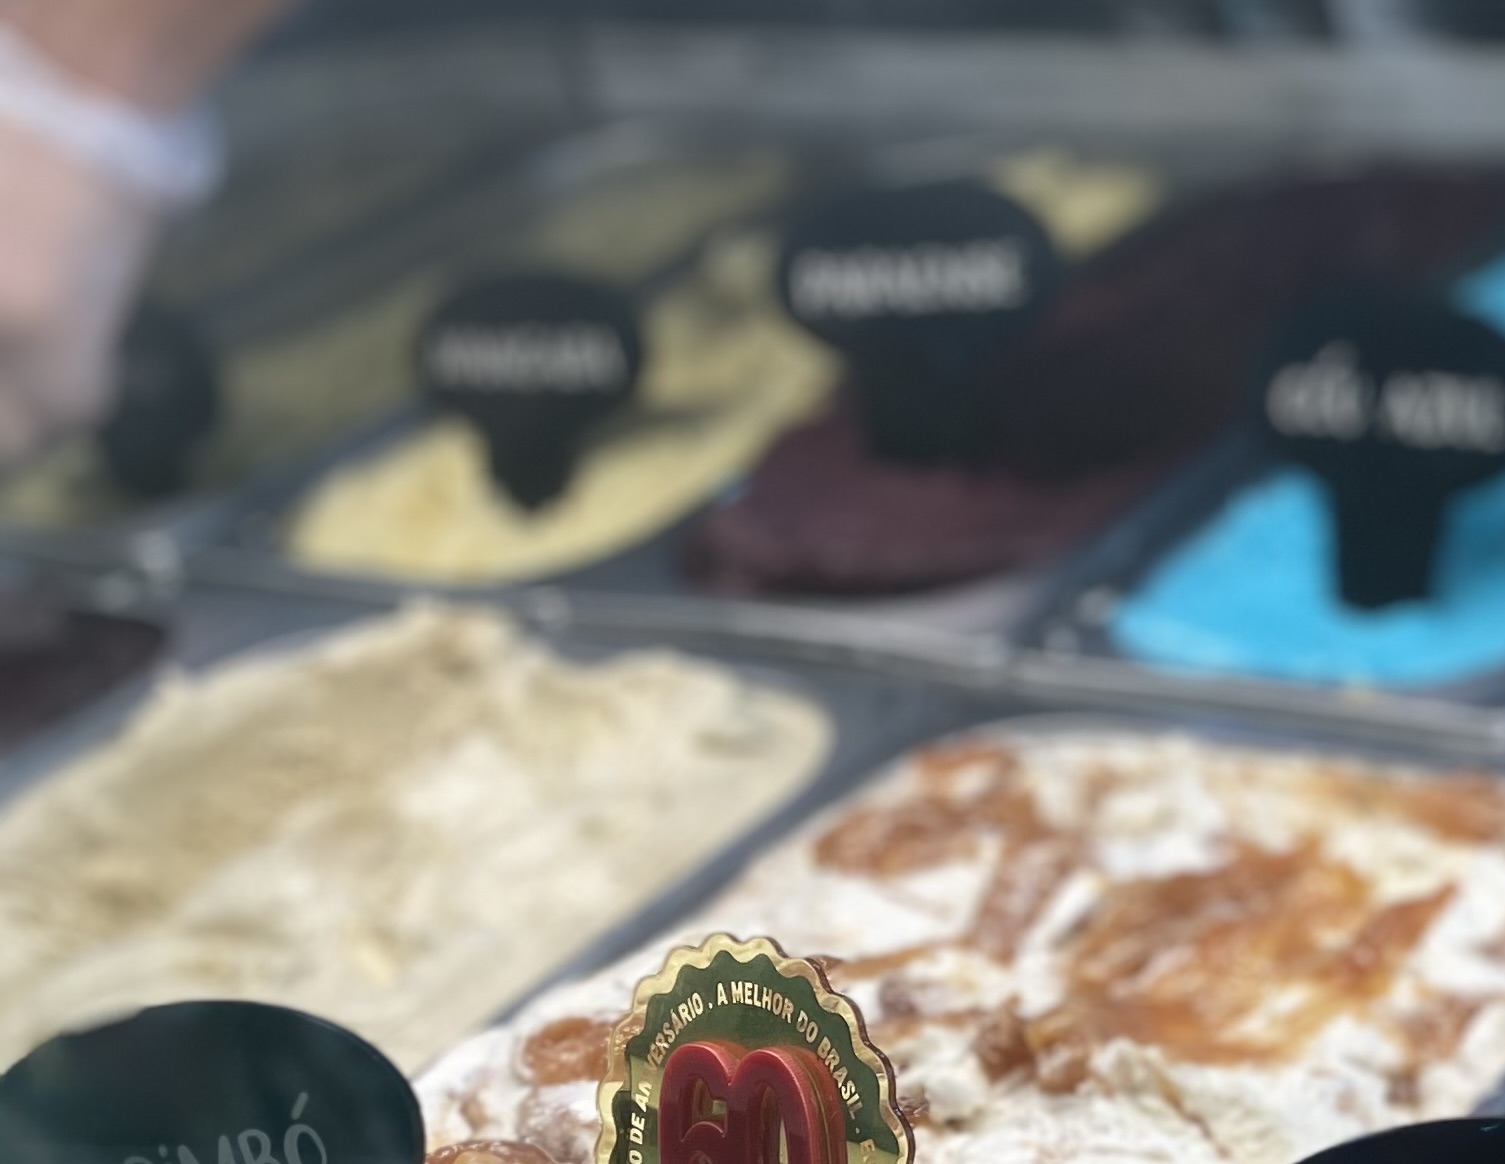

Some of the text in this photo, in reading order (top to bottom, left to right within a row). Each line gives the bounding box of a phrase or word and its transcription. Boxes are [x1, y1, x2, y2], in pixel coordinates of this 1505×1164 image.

[629, 1112, 646, 1145] DE
[717, 982, 729, 1006] A
[731, 981, 795, 1023] MELHOR
[796, 1010, 818, 1043] DO
[817, 1036, 863, 1120] BRASIL
